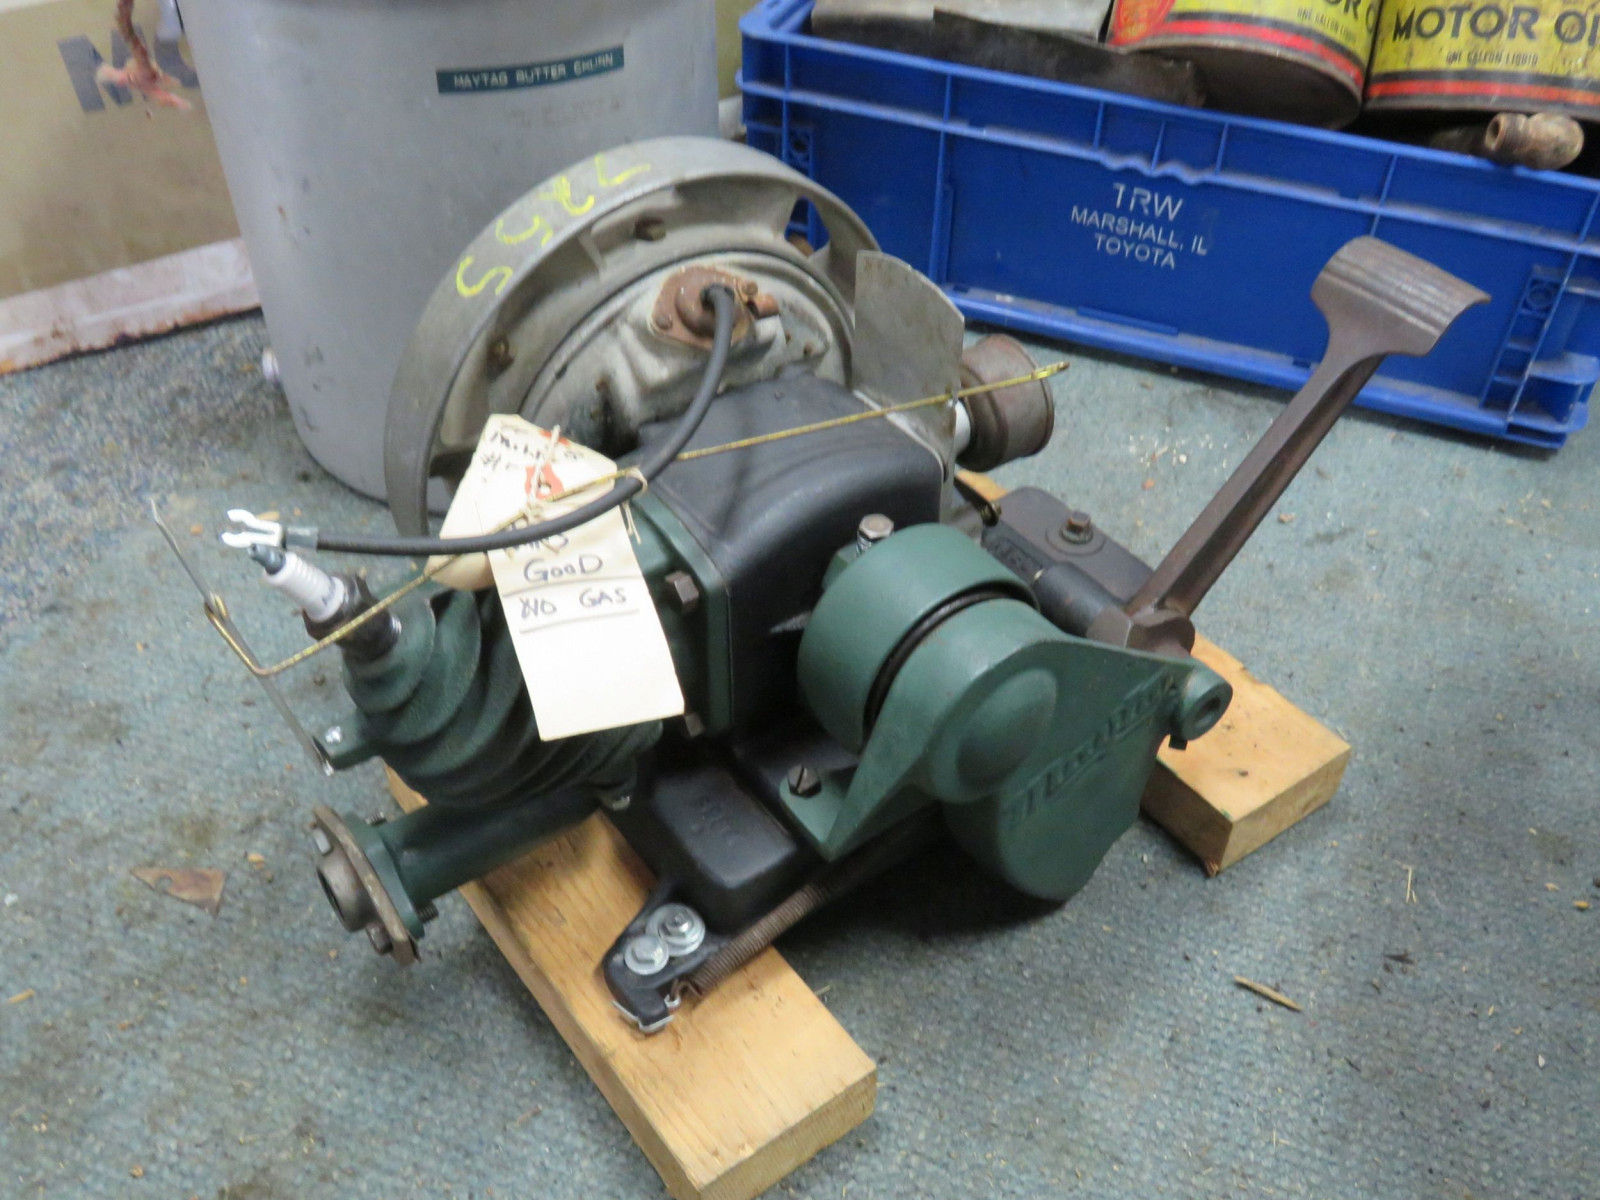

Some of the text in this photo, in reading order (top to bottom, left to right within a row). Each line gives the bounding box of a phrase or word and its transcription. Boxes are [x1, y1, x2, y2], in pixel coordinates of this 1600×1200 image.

[1393, 4, 1539, 42] MOTOR
[515, 63, 566, 84] BUTTER
[1113, 182, 1183, 222] TRW
[1070, 205, 1208, 256] MARSHALL, IL
[1094, 232, 1176, 270] TOYOTA
[579, 587, 627, 608] GAS
